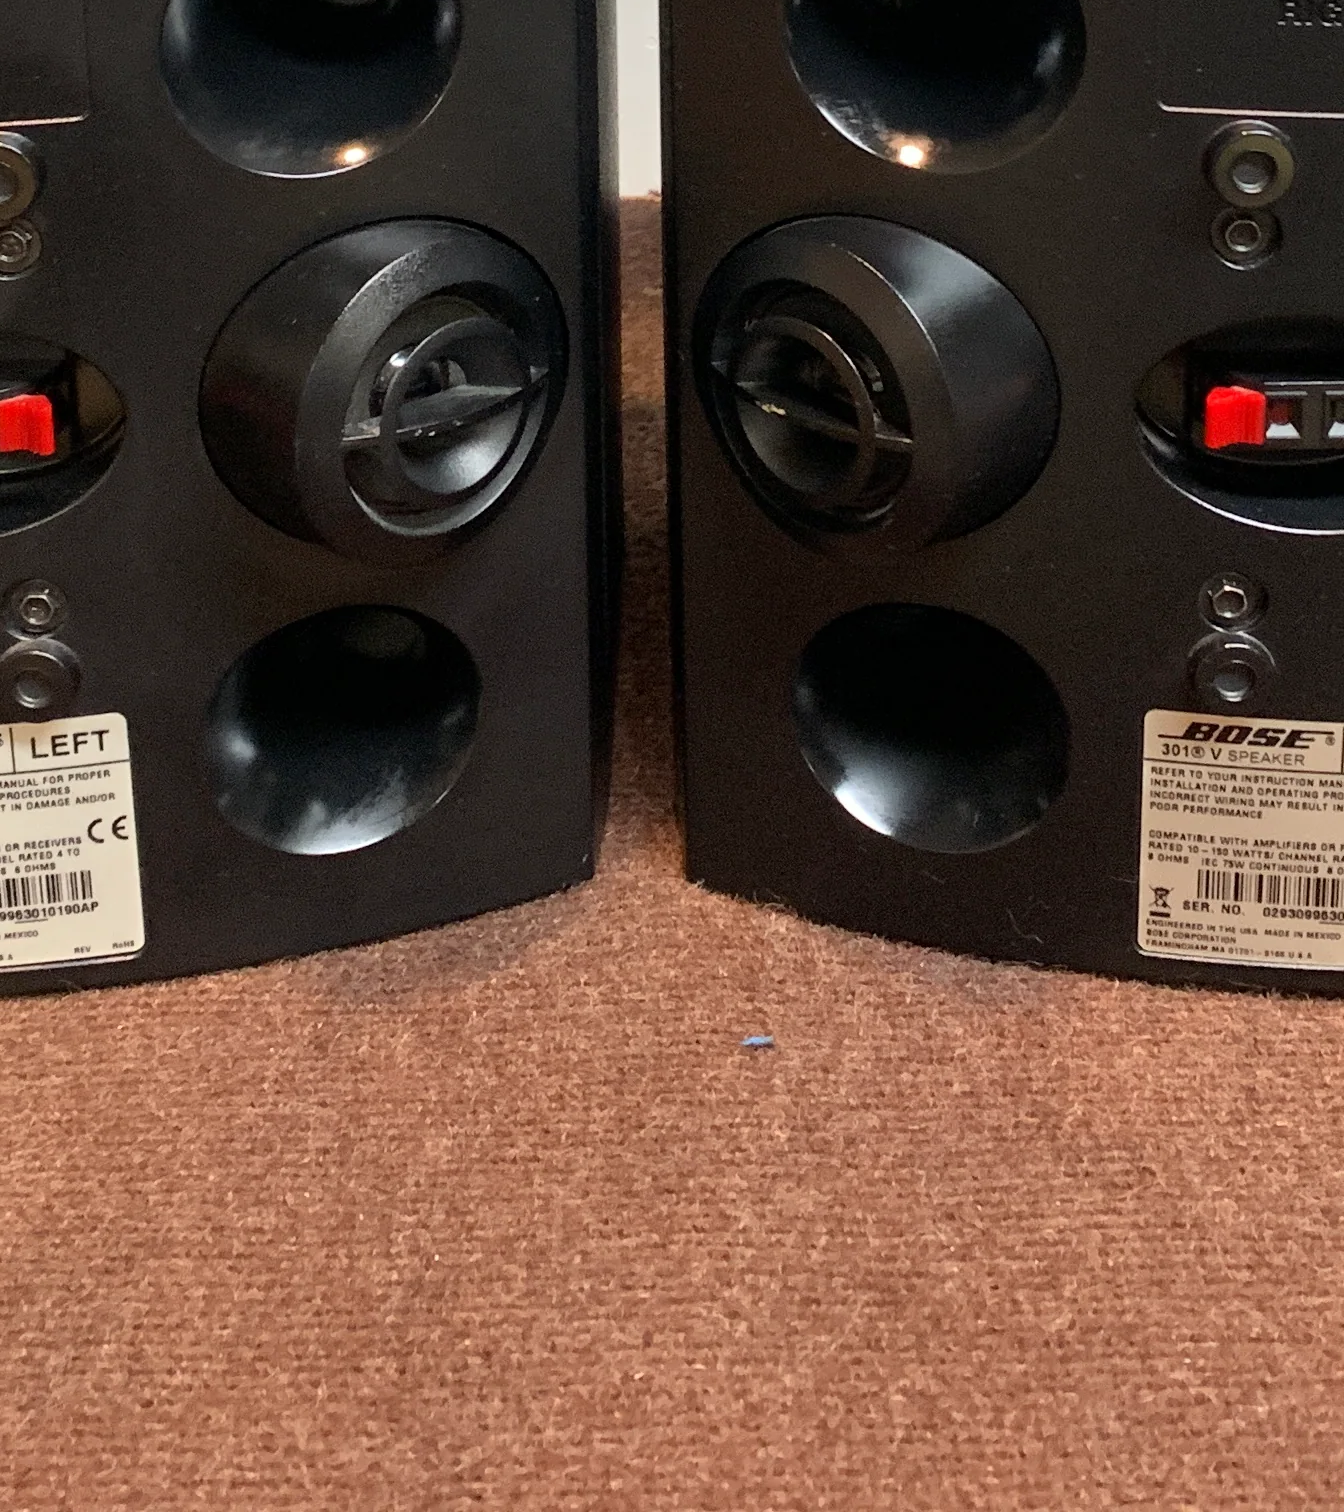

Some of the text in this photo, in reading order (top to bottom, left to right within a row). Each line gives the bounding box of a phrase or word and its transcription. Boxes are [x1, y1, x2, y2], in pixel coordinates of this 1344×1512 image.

[30, 729, 110, 759] LEFT
[1210, 747, 1223, 760] V
[1227, 749, 1305, 766] SPEAKER
[43, 777, 64, 785] FOR
[68, 770, 111, 782] PROPER
[1151, 766, 1186, 778] REFER
[1189, 770, 1203, 779] TO
[1207, 772, 1237, 782] YOUR
[1241, 774, 1314, 787] INSTRUCTION
[0, 786, 71, 801] PROCEDURES
[1150, 778, 1227, 793] INSTALLATION
[1231, 784, 1253, 795] AND
[1257, 788, 1319, 799] OPERATING
[11, 803, 22, 811] IN
[26, 798, 70, 810] DAMAGE
[75, 792, 116, 805] AND/OR
[1149, 801, 1263, 819] POOR PERFORMANCE
[1150, 790, 1210, 803] INCORRECT
[1215, 796, 1255, 807] WIRING
[1259, 799, 1283, 809] MAY
[1287, 801, 1328, 812] RESULT
[1333, 803, 1344, 812] IN
[5, 843, 20, 852] OR
[24, 836, 82, 850] RECEIVERS
[1149, 829, 1216, 844] COMPATIBLE
[1219, 836, 1248, 846] WITH
[1252, 839, 1317, 851] AMPLIFIERS
[1320, 842, 1336, 852] OR
[19, 850, 53, 862] RATED
[67, 848, 80, 857] TO
[1148, 840, 1183, 853] RATED
[1188, 845, 1199, 854] 10
[1278, 852, 1328, 864] CHANNEL
[24, 862, 56, 873] OHMS
[1157, 853, 1190, 865] OHMS
[1201, 857, 1218, 867] IEC
[1223, 860, 1245, 869] 75W
[1249, 861, 1319, 874] CONTINUOUS
[1182, 900, 1215, 914] SER.
[1221, 904, 1245, 916] NO.
[4, 930, 39, 939] MEXICO
[1146, 918, 1203, 931] ENGINEERED
[1219, 925, 1236, 934] THE
[1264, 929, 1290, 937] MADE
[1294, 930, 1303, 938] IN
[1306, 932, 1342, 940] MEXICO
[1172, 931, 1237, 944] CORPORATION
[74, 946, 91, 954] REV
[1145, 939, 1208, 951] FRAMINGHAM
[1211, 945, 1225, 953] MA
